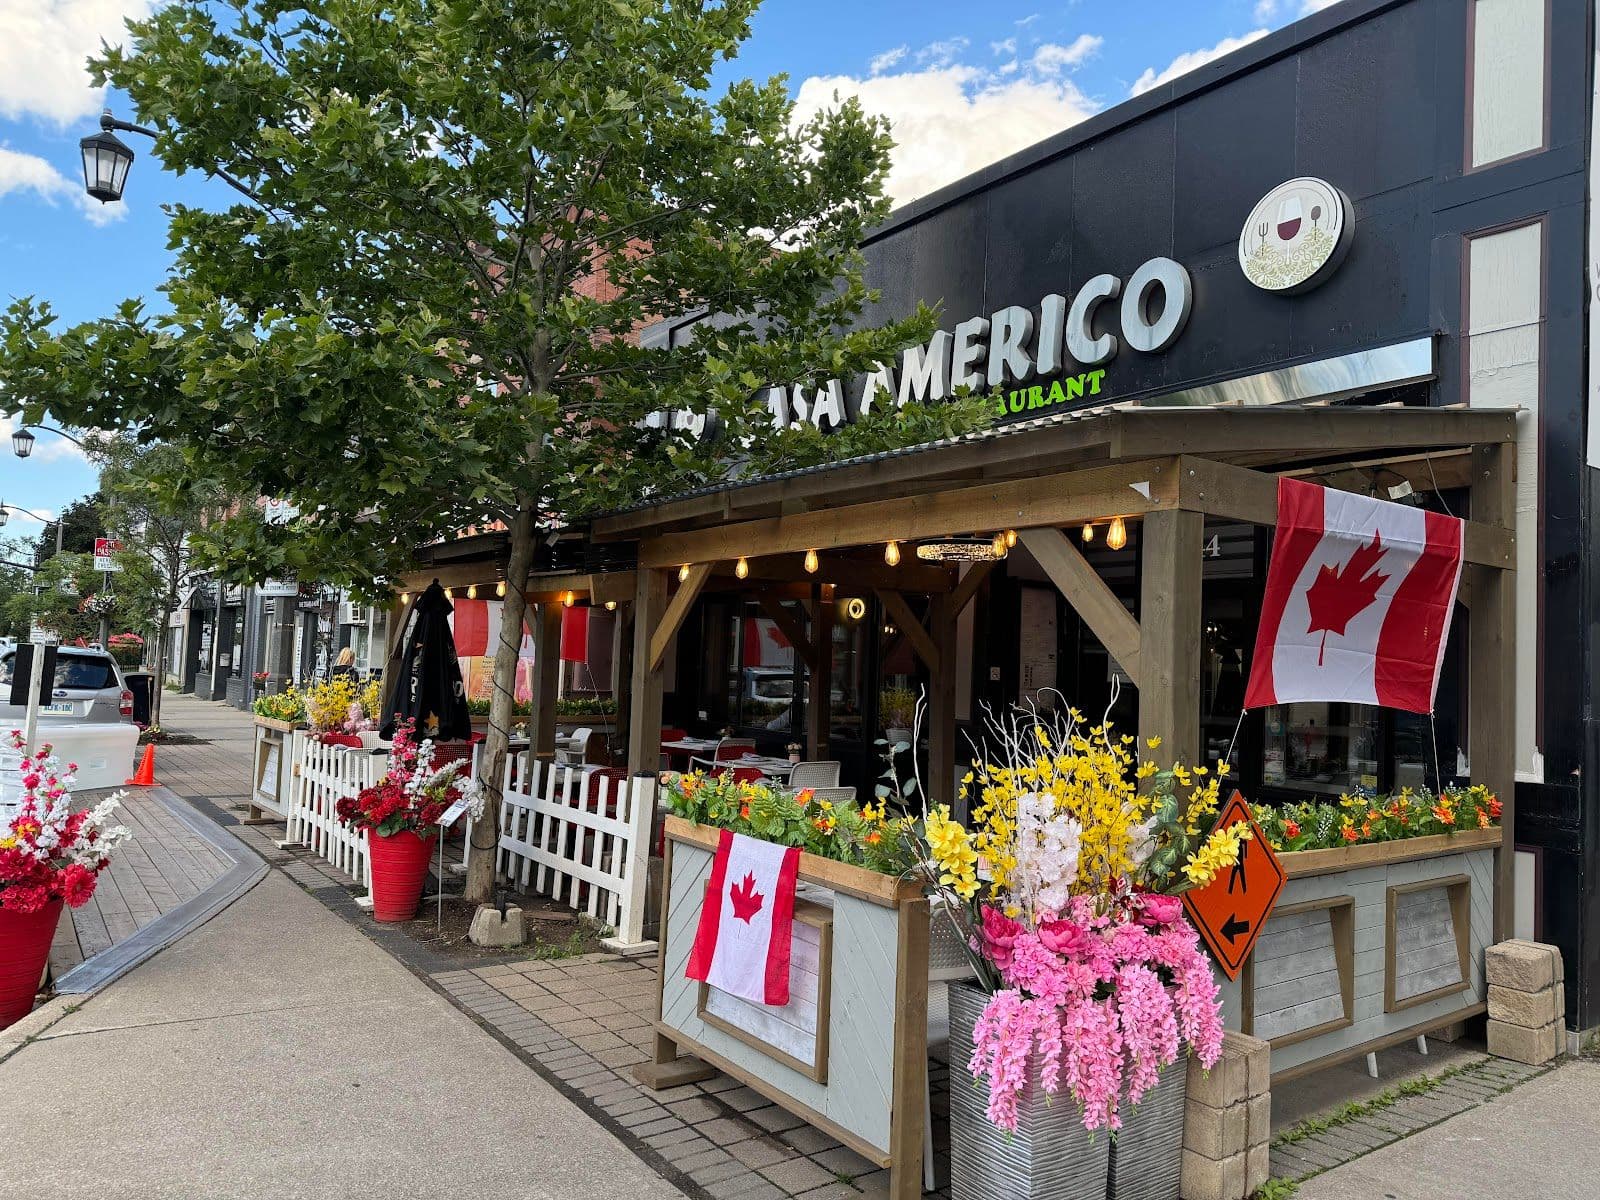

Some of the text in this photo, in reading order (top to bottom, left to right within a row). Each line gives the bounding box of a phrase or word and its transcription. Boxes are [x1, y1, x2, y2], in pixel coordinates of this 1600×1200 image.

[860, 256, 1193, 417] AMERICO
[977, 369, 1106, 416] AURANT
[1202, 534, 1221, 557] 4
